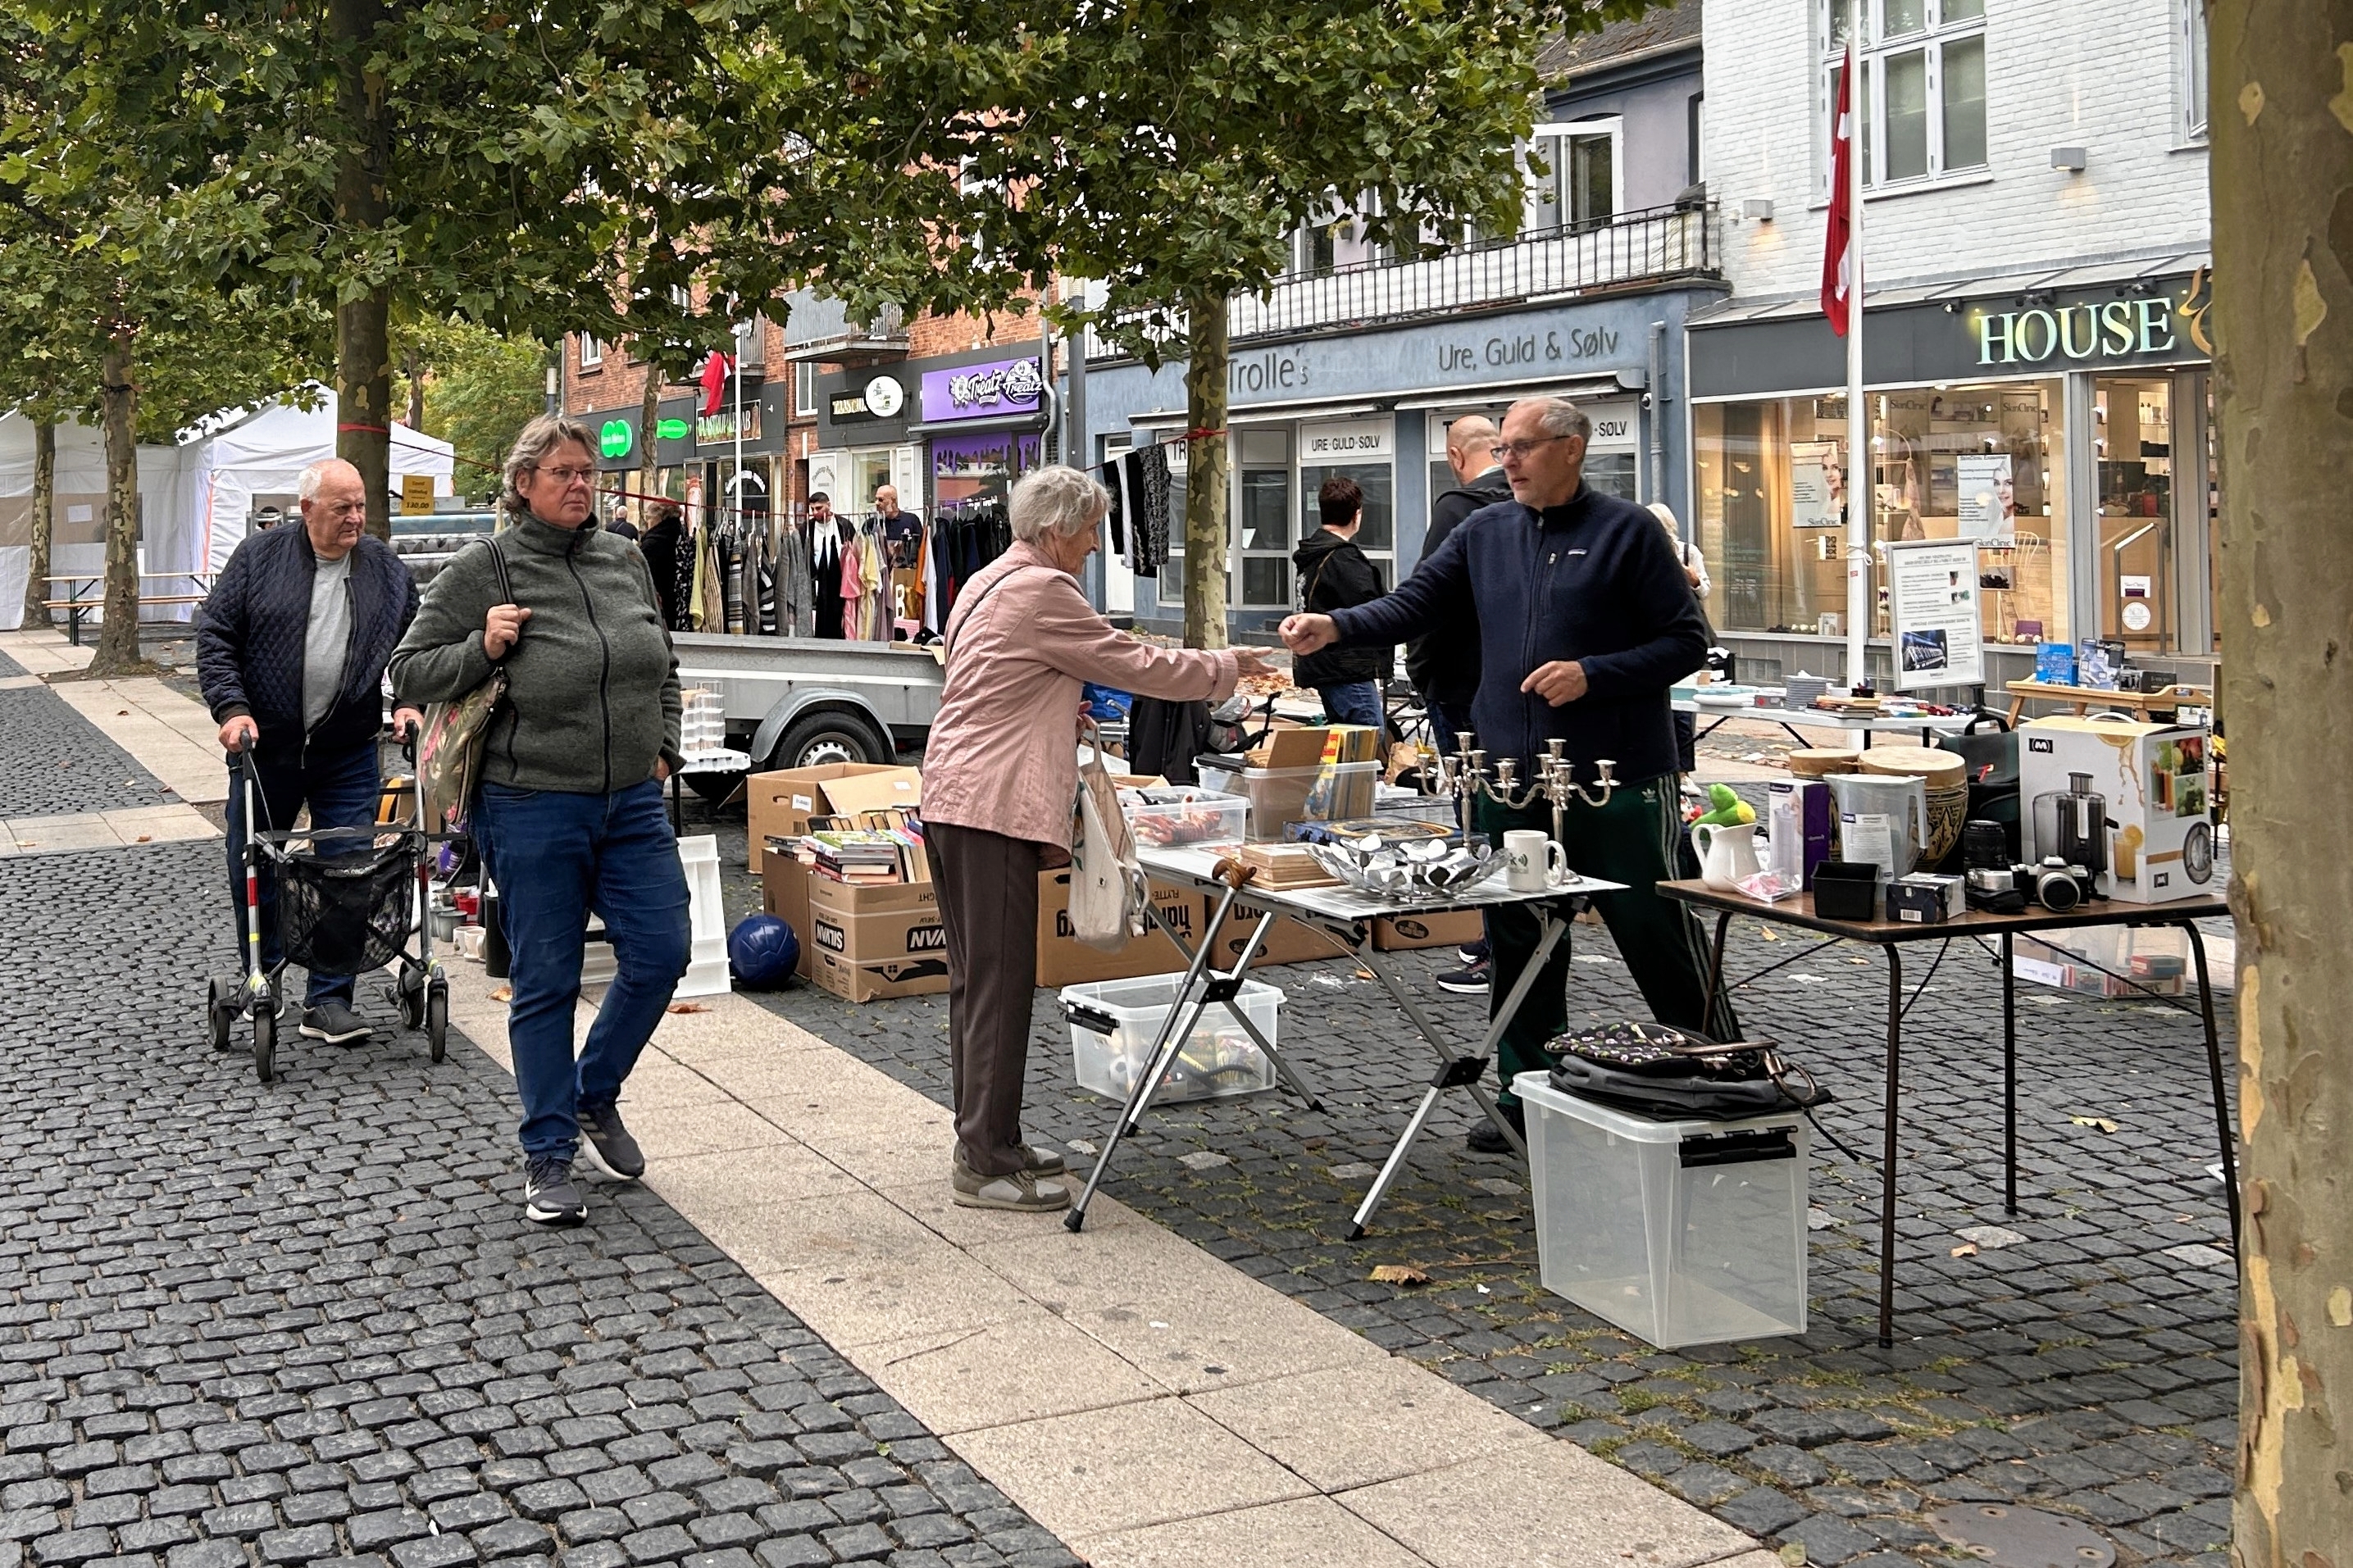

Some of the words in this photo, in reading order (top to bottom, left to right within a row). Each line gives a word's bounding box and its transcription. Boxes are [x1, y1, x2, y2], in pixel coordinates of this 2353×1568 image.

[1975, 298, 2175, 365] HOUSE
[1440, 344, 1476, 370] Ure,
[1486, 337, 1535, 366] Guld
[1545, 331, 1561, 360] &
[1571, 326, 1618, 357] Sølv
[1002, 380, 1042, 394] Treatz
[918, 893, 935, 902] GHT
[817, 924, 844, 950] SILVAN
[910, 929, 946, 948] VAN
